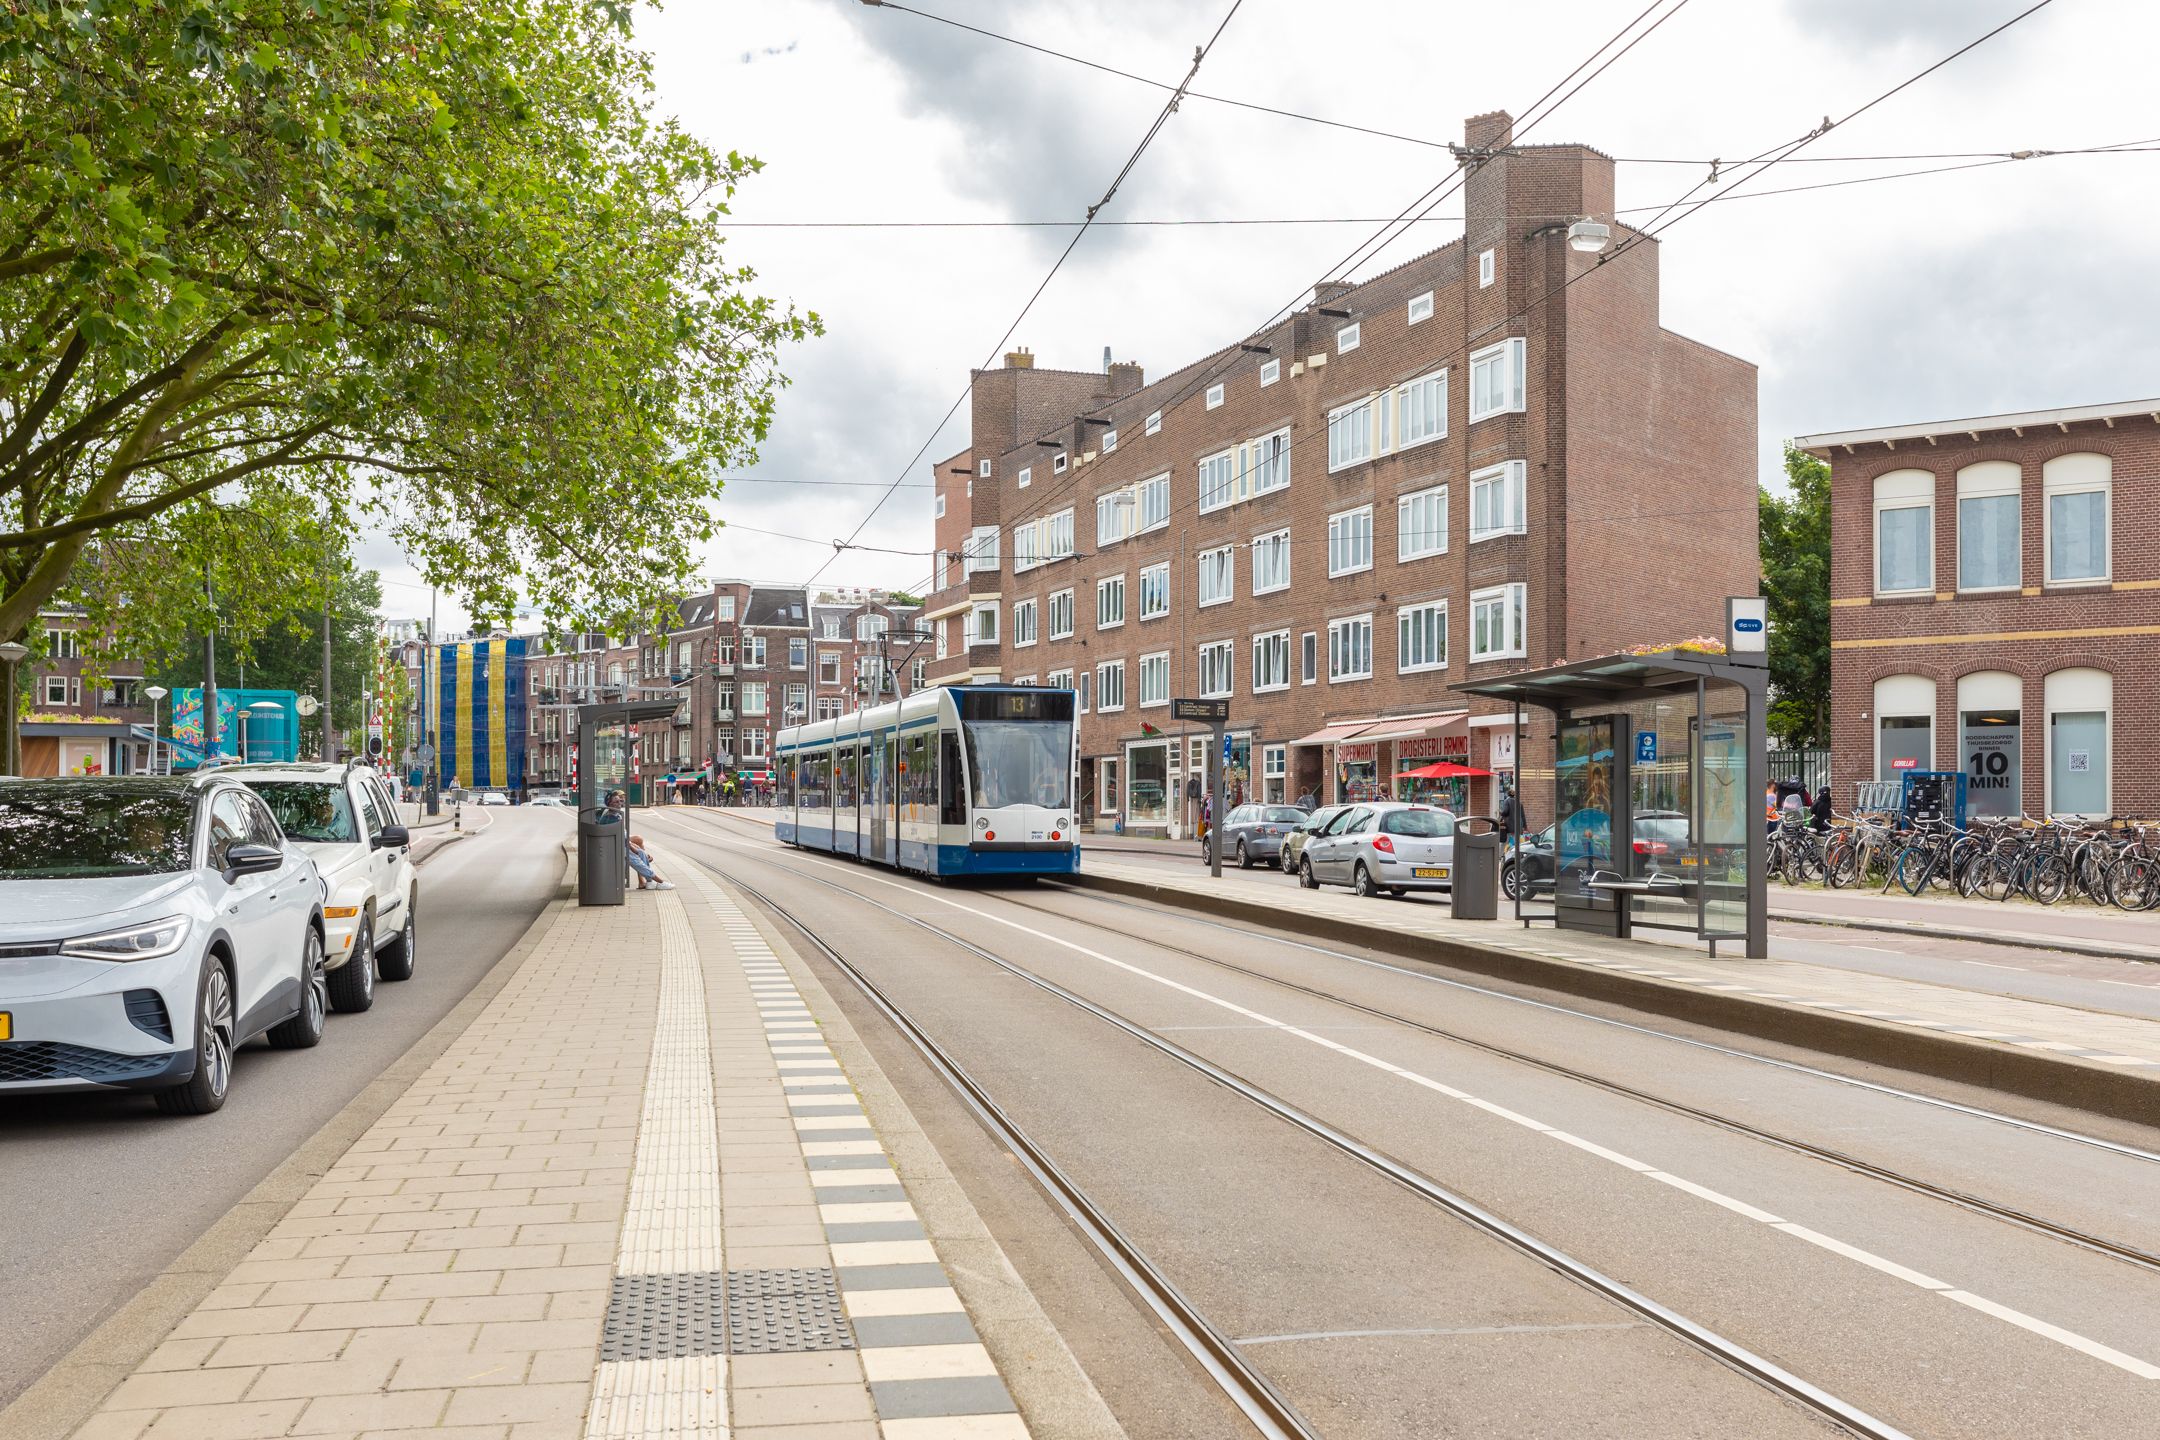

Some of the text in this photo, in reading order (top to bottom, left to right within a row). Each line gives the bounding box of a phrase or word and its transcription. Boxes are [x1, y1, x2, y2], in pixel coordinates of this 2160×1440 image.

[1009, 696, 1024, 713] 13
[1338, 743, 1376, 762] SUPERMARKT
[1398, 735, 1468, 759] DROGISTERIJ ARMINO
[1970, 751, 2008, 775] 10
[1970, 776, 2009, 788] MIN!
